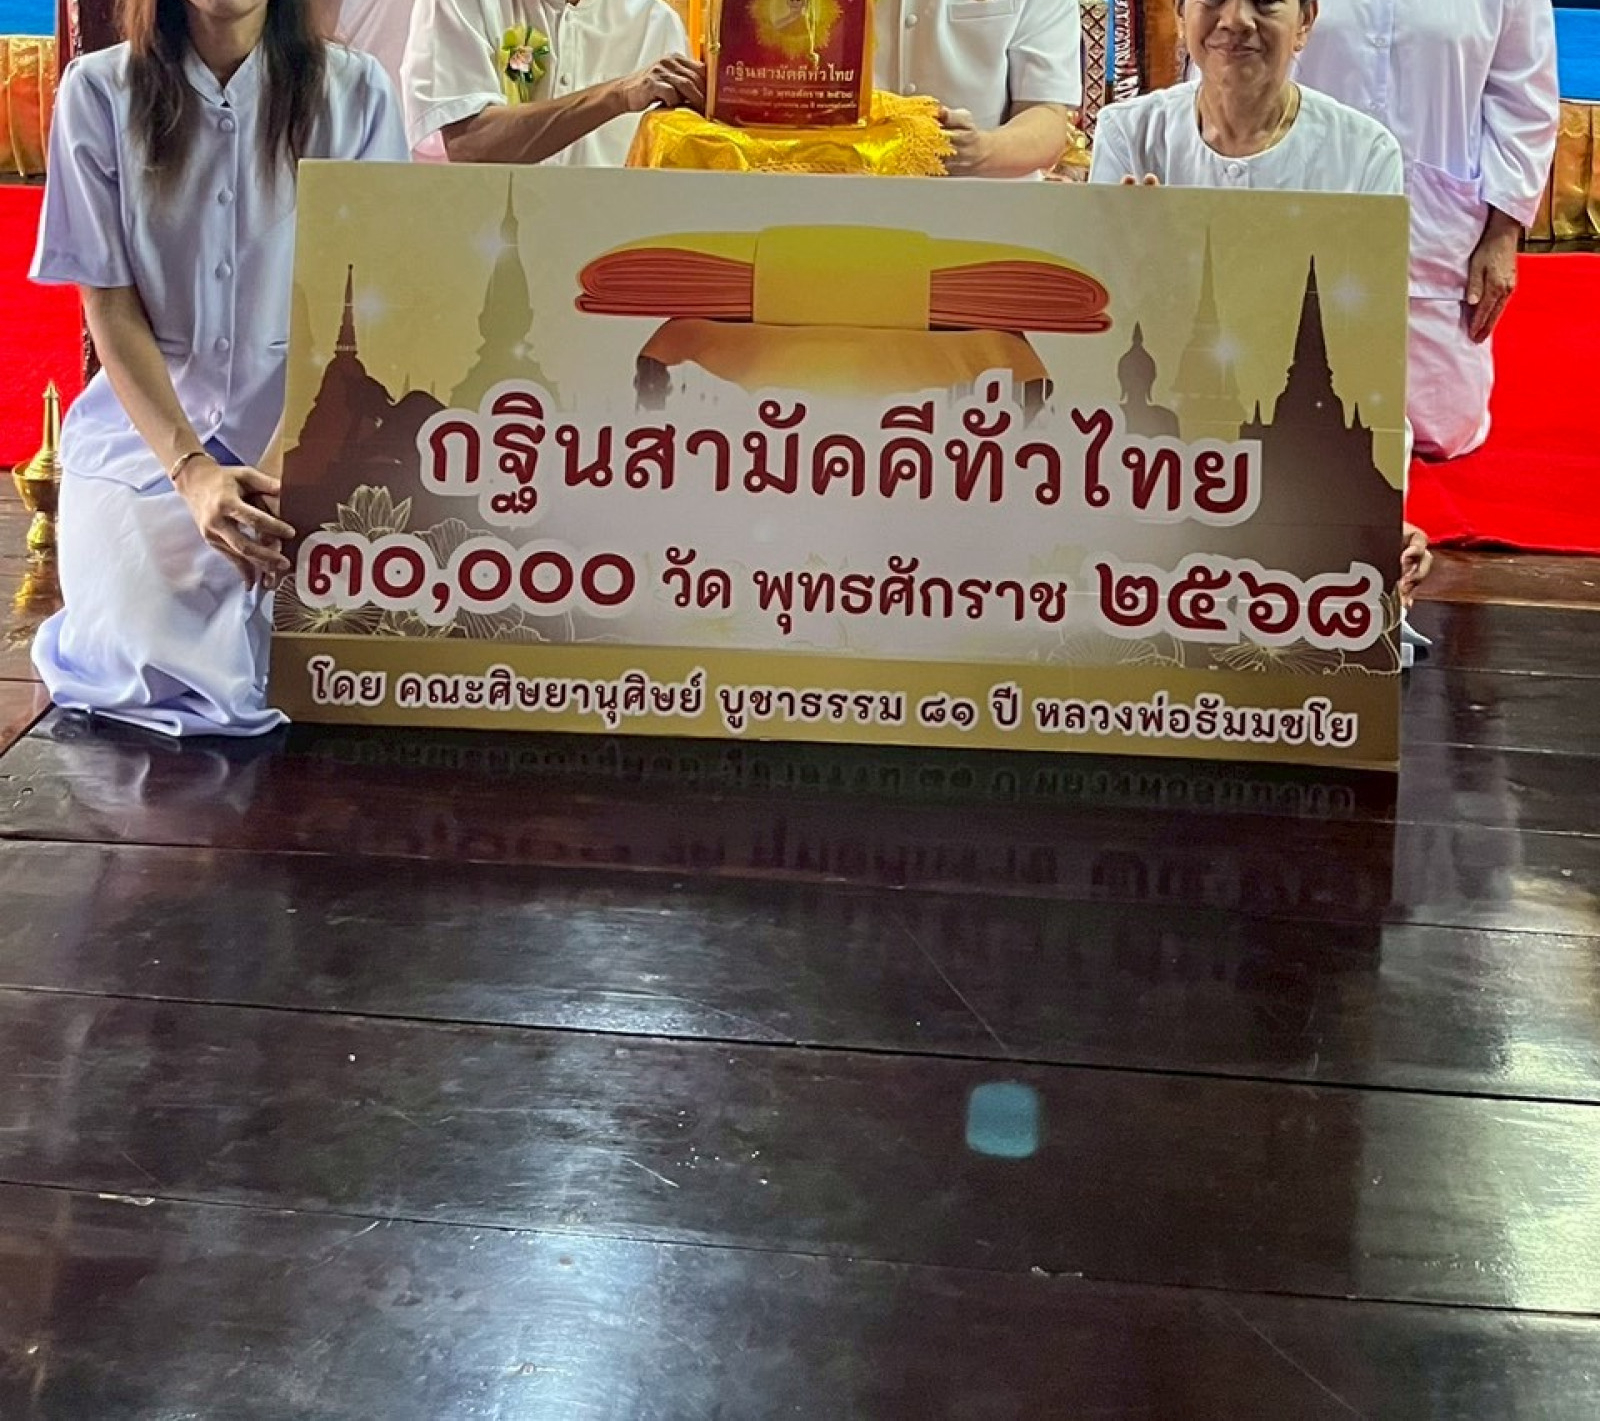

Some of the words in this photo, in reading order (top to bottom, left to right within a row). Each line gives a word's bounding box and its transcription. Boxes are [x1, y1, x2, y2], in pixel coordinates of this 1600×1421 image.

[429, 382, 1249, 514] กฐินสามัคคีทั่วไทย
[307, 543, 636, 611] ๓๐,๐๐๐
[665, 549, 731, 608] วัด
[755, 559, 1067, 633] พุทธศักราช
[1097, 564, 1371, 639] ๒๕๖๘
[312, 660, 382, 701] โดย
[401, 669, 702, 724] คณะศิษยานุศิษย์
[720, 687, 902, 729] บูชาธรรม
[920, 697, 975, 726] ๘๑
[992, 685, 1018, 726] ปี
[1036, 695, 1354, 743] หลวงพ่อธัมมชโย
